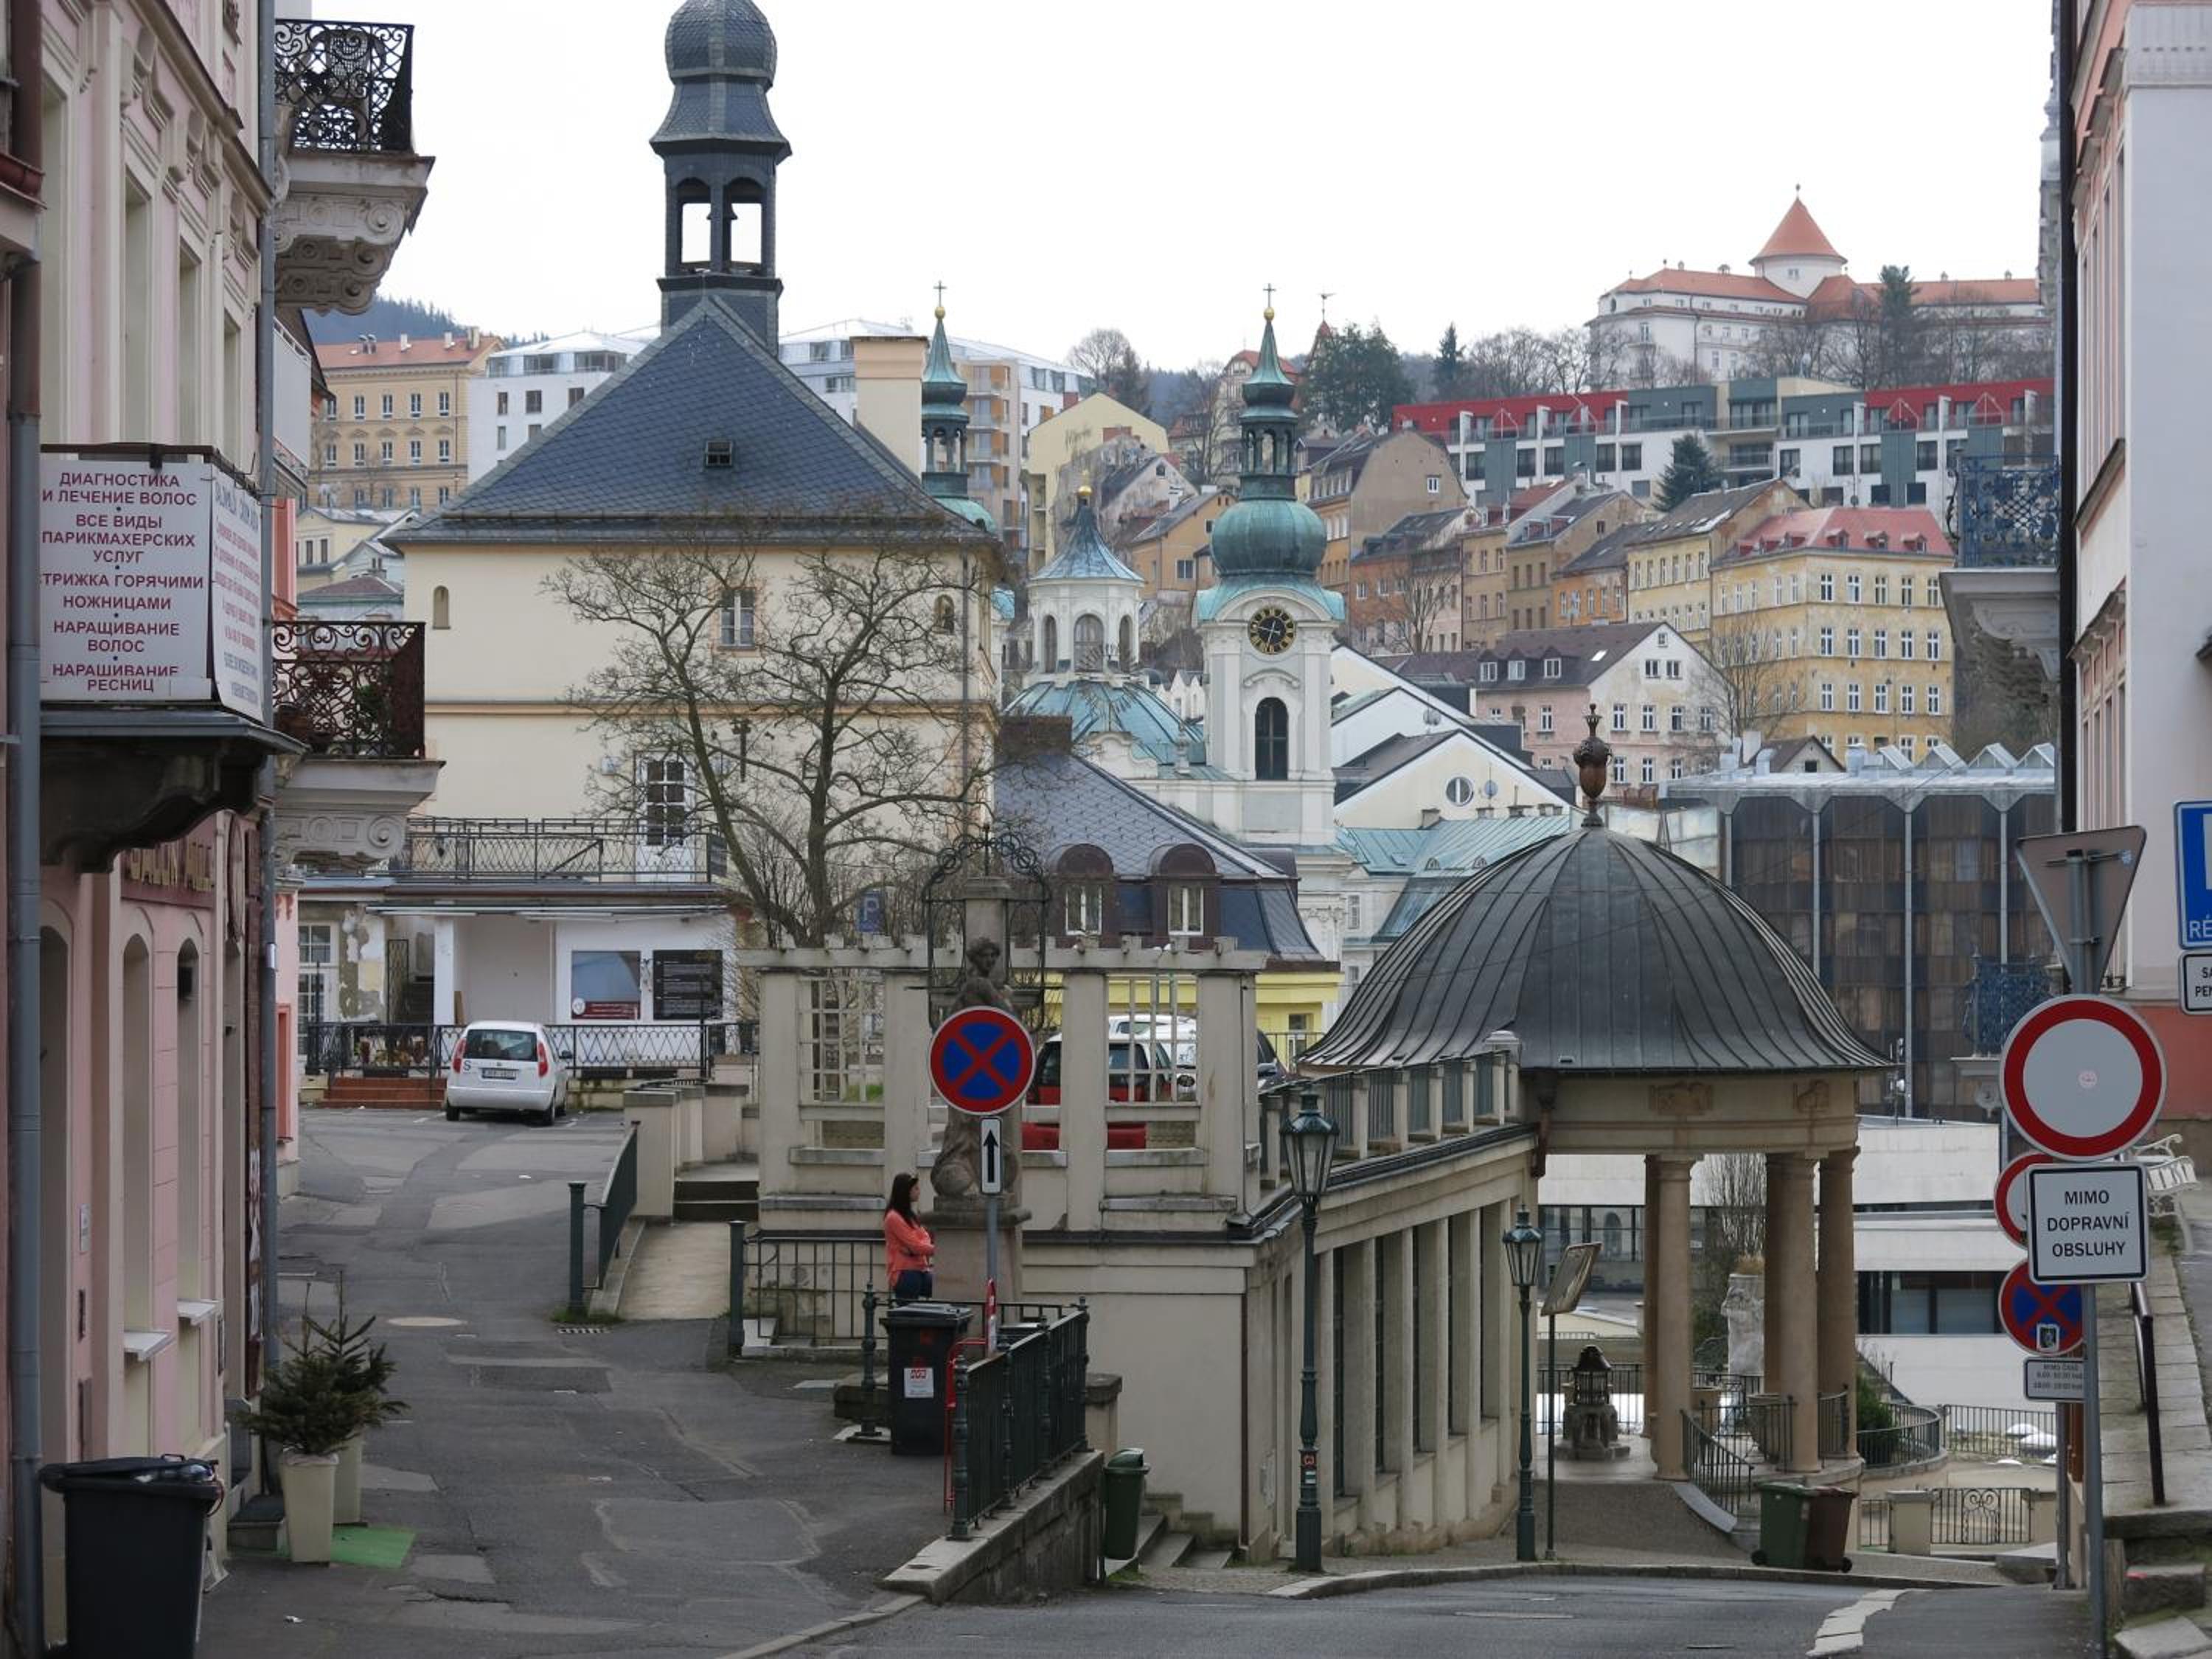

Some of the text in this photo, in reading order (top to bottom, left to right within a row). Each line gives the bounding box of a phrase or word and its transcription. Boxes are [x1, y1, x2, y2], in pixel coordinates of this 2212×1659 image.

[59, 473, 180, 488] ДИАГНОСТИКА
[42, 490, 197, 506] И ЛЕЧЕНИЕ ВОЛОС
[76, 515, 162, 530] ВСЕ ВИДЫ
[42, 532, 195, 547] ПАРИКМАХЕРСКИХ
[93, 551, 145, 563] УСЛУГ
[40, 573, 204, 589] ТРИЖКА ГОРЯЧИМИ
[63, 596, 171, 612] НОЖНИЦАМИ
[53, 622, 180, 638] НАРАЩИВАНИЕ
[88, 640, 145, 652] ВОЛОС
[87, 680, 155, 692] РЕСНИЦ
[2065, 1190, 2110, 1205] MIMO
[2047, 1211, 2129, 1232] DOPRAVNÍ
[2052, 1241, 2126, 1257] OBSLUHY
